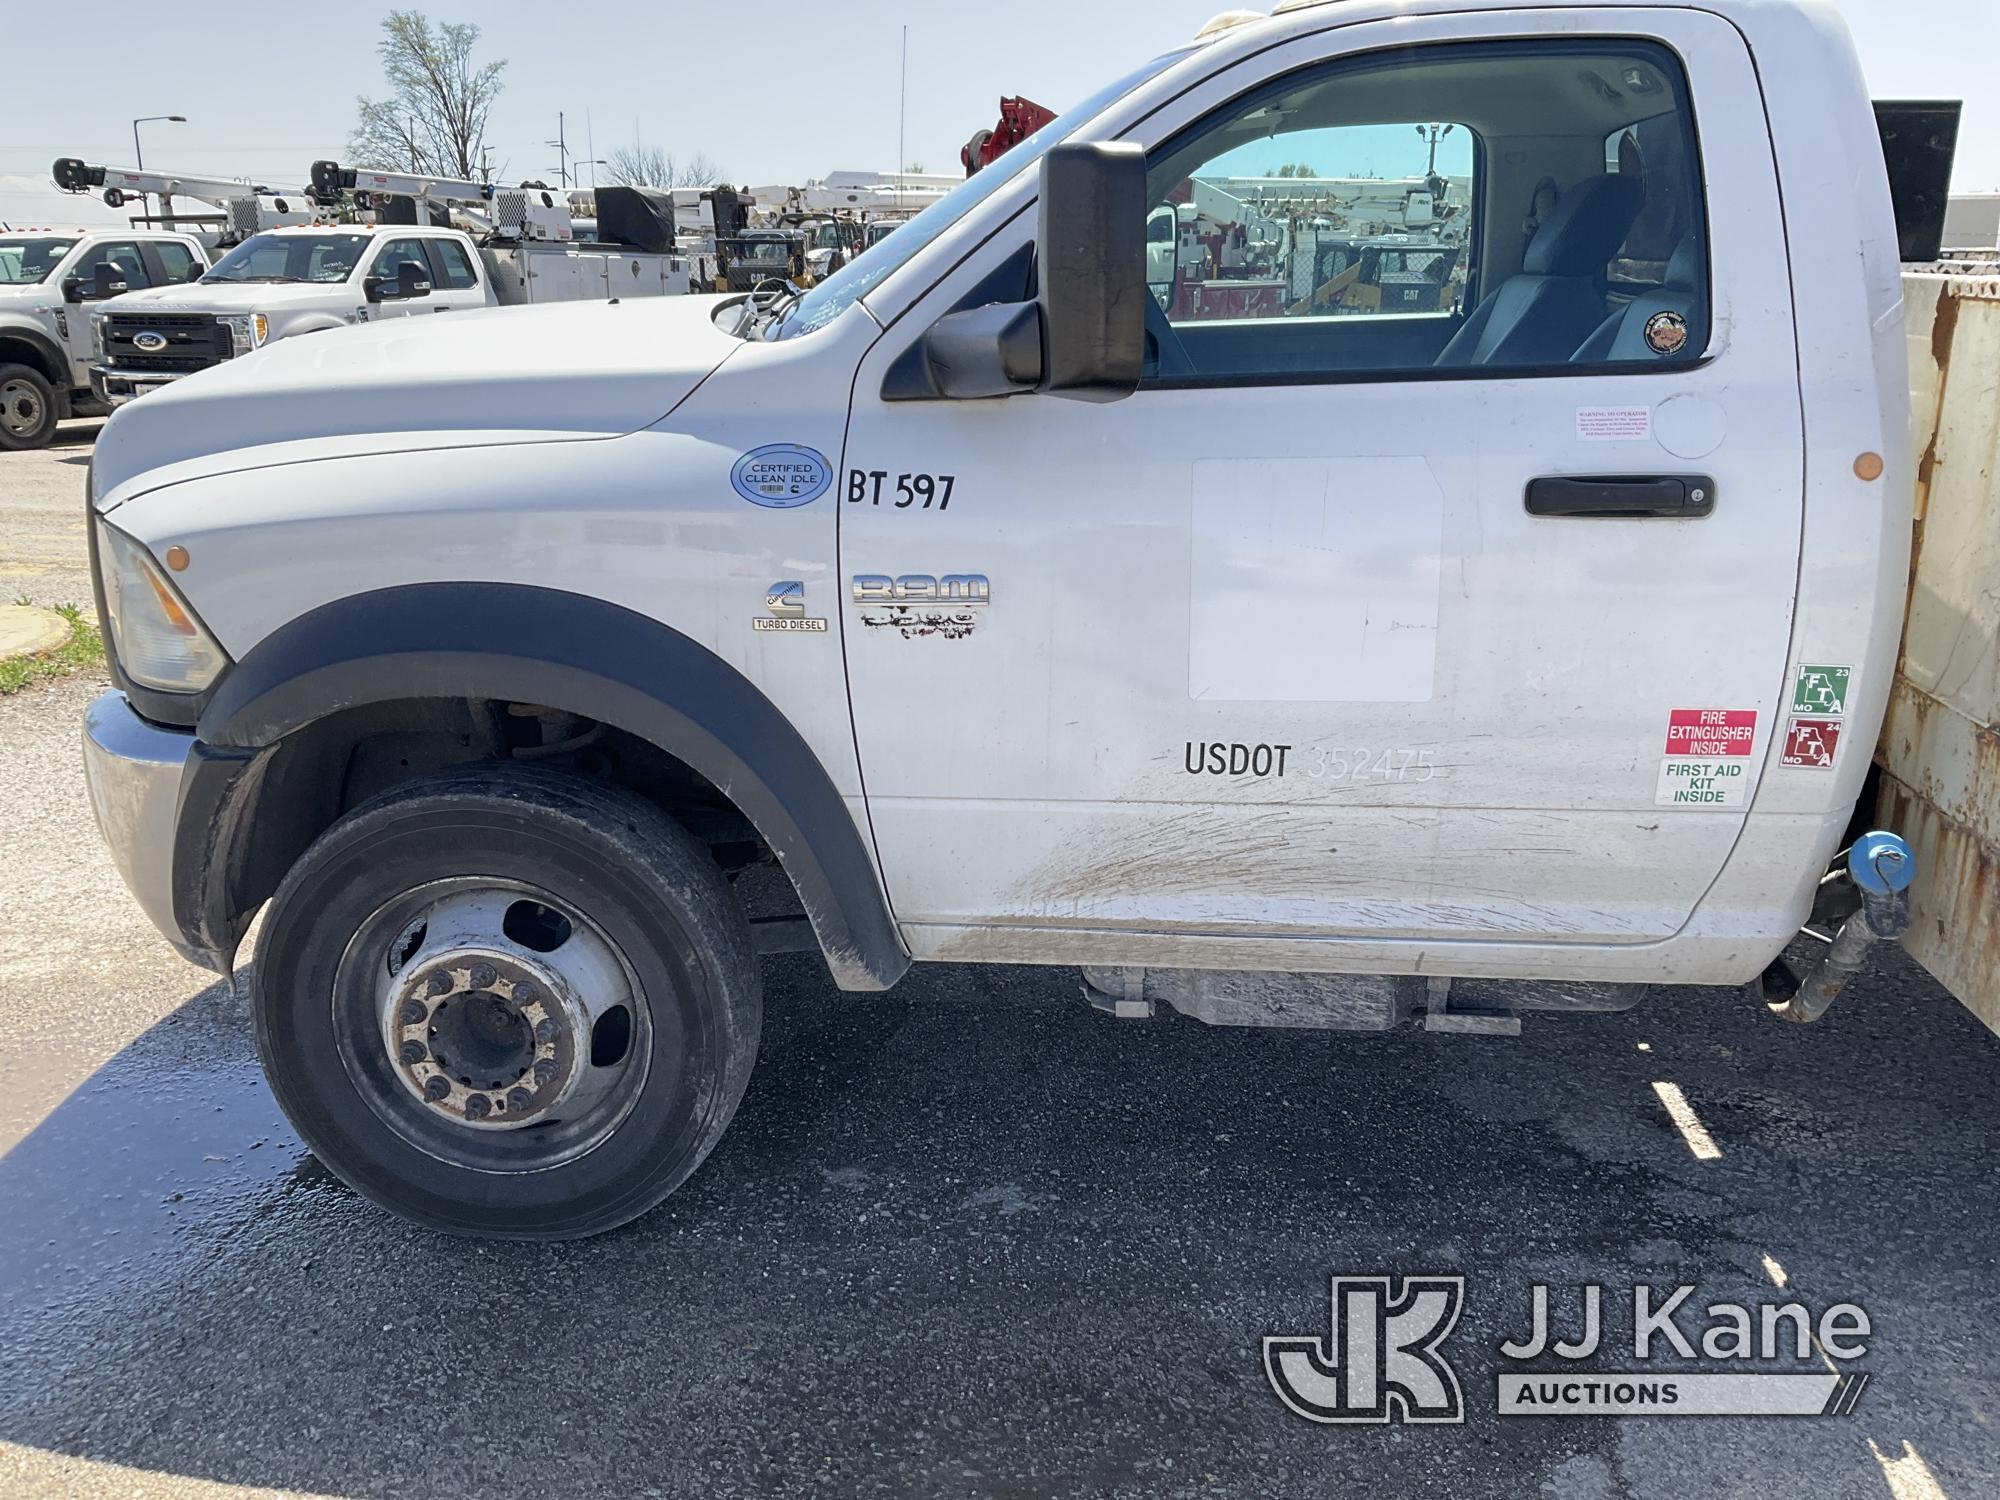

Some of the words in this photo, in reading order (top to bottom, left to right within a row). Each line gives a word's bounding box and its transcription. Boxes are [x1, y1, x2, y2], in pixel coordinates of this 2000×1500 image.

[751, 273, 766, 284] CAT
[1404, 289, 1419, 300] CAT
[752, 464, 812, 472] CERTIFIED
[745, 475, 786, 483] CLEAN
[791, 475, 818, 483] IDLE
[848, 469, 888, 505] BT
[894, 473, 955, 511] 597
[852, 574, 989, 601] RAM
[767, 582, 799, 605] Cummins
[757, 620, 788, 629] TURBO
[790, 620, 822, 630] DIESEL
[1835, 669, 1849, 677] 23
[1794, 704, 1813, 712] MO
[1700, 711, 1727, 725] FIRE
[1826, 723, 1841, 731] 24
[1669, 726, 1753, 740] EXTINGUISHER
[1689, 741, 1728, 755] INSIDE
[1185, 742, 1292, 777] USDOT
[1308, 746, 1436, 782] 352475
[1666, 764, 1712, 776] FIRST
[1714, 765, 1742, 777] AID
[1689, 778, 1715, 790] KIT
[1673, 791, 1726, 802] INSIDE
